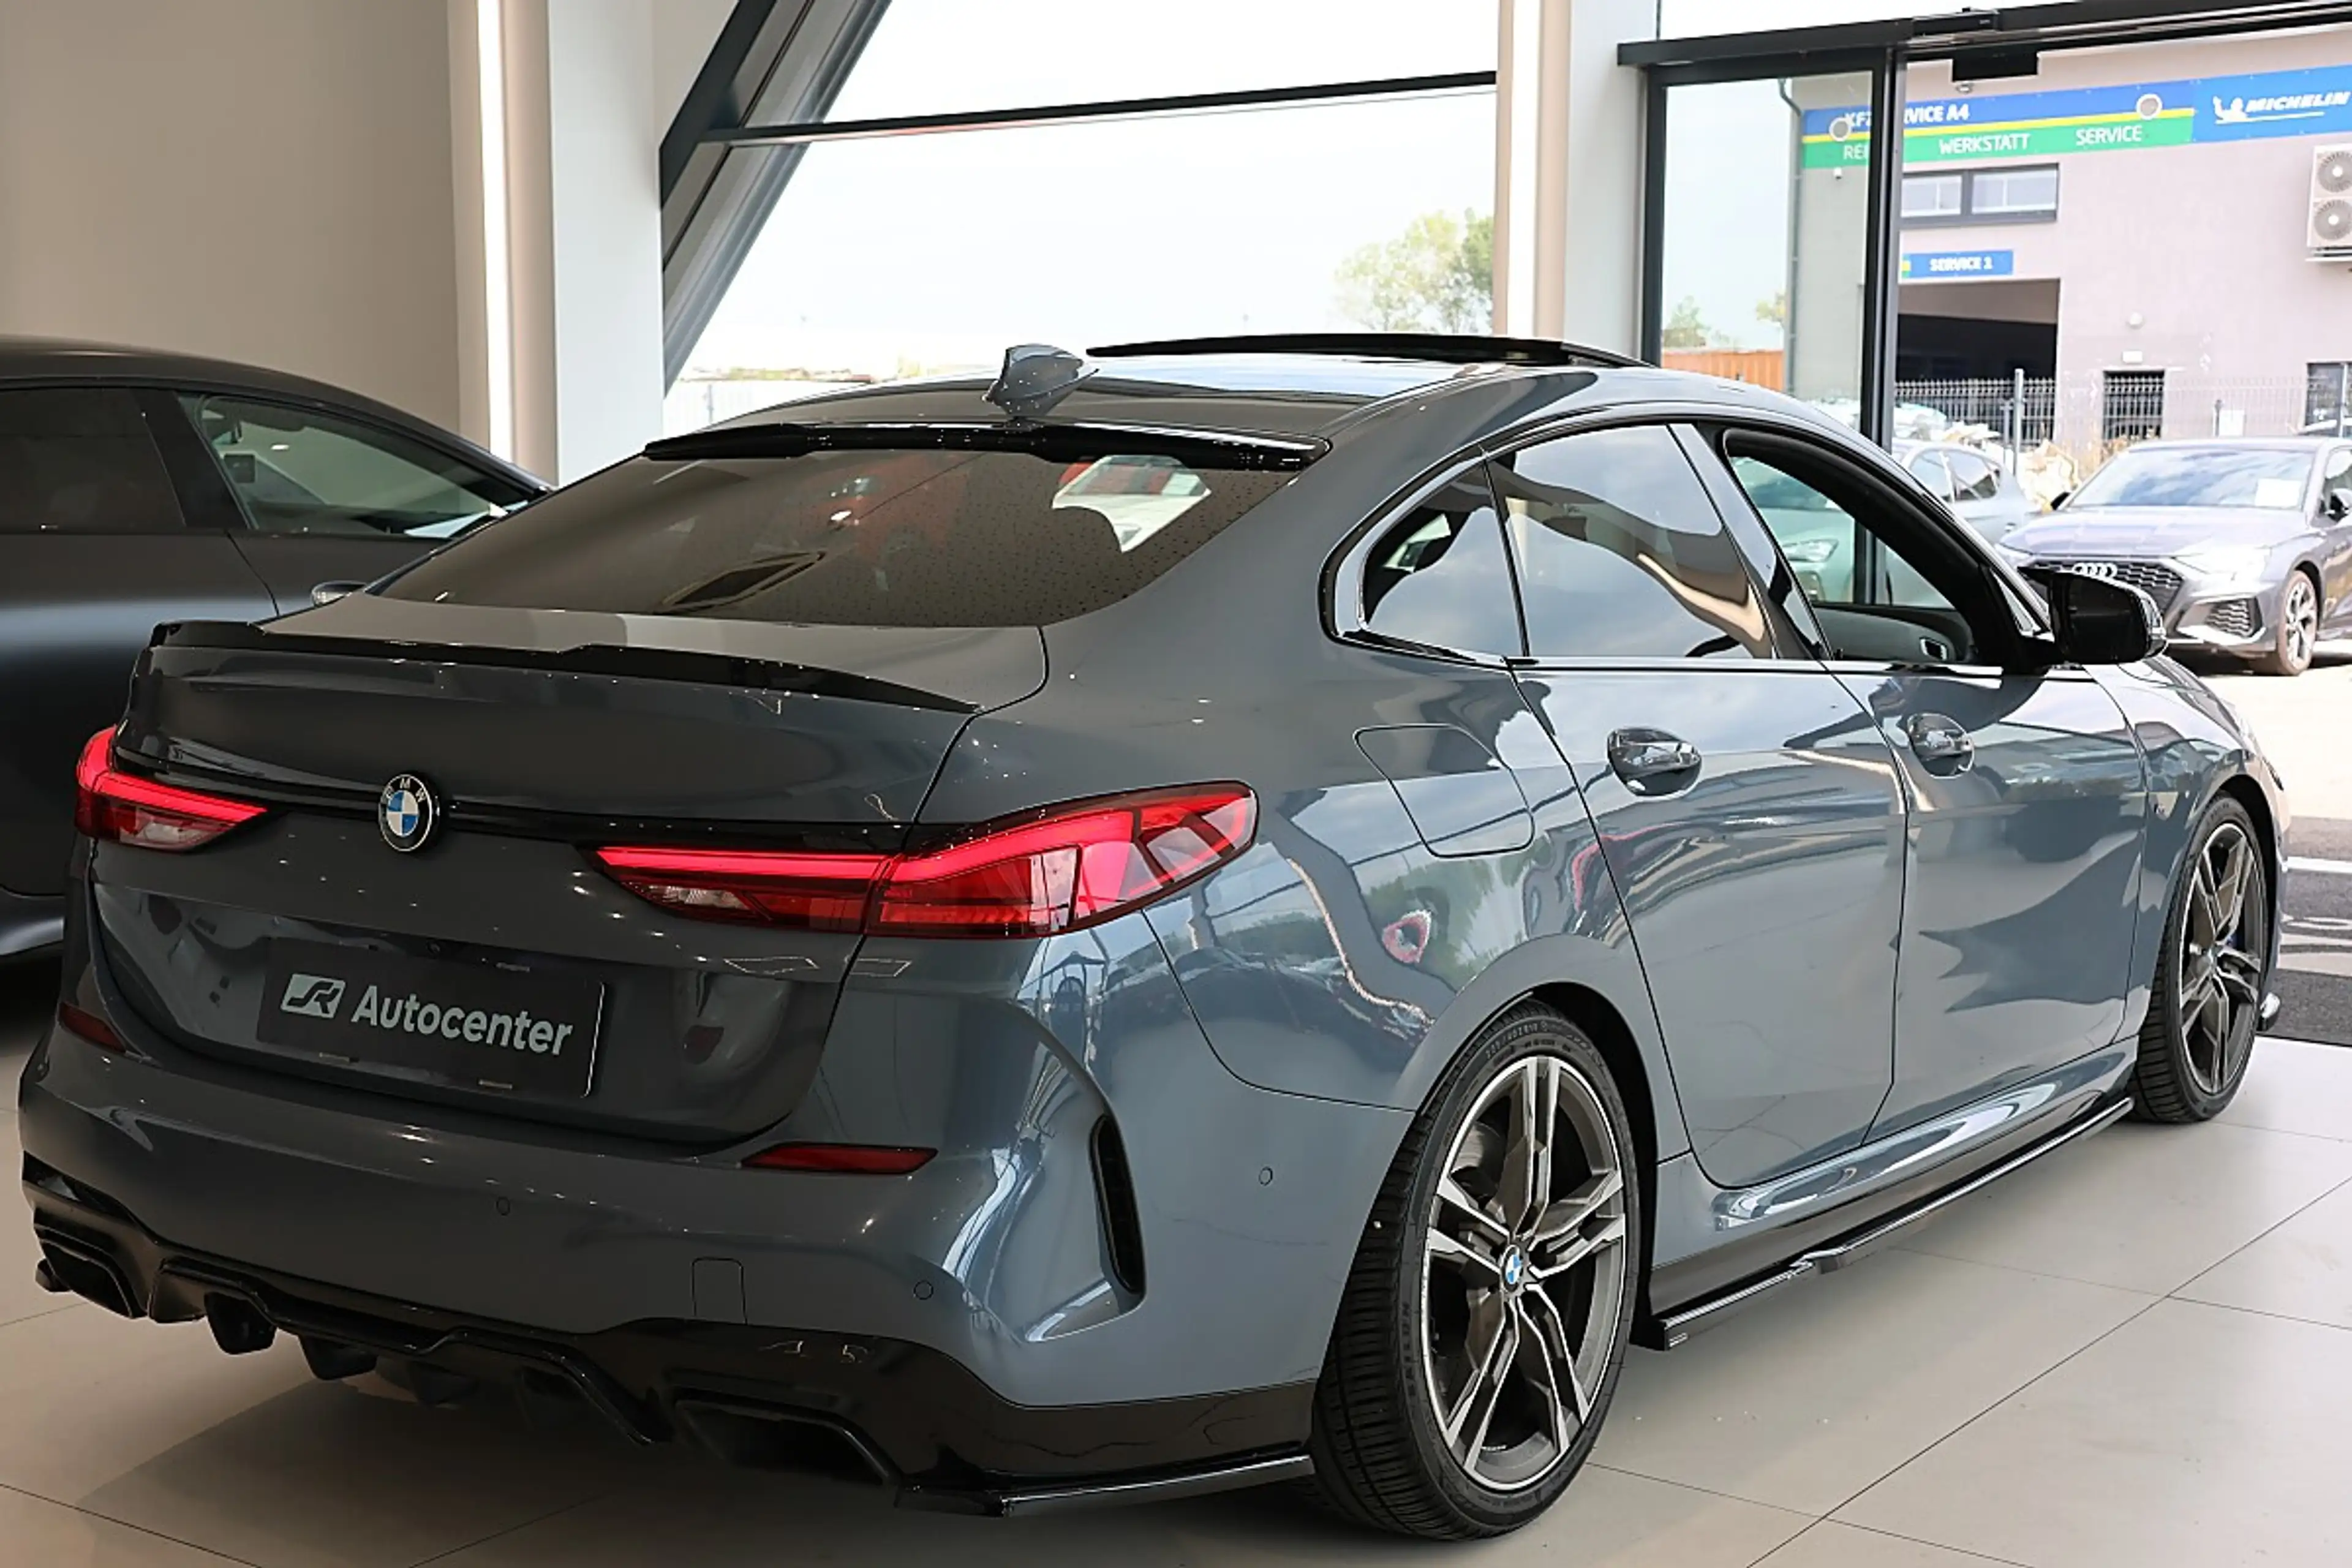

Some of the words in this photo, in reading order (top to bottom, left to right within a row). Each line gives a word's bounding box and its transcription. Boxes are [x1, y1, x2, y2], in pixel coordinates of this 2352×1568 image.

[1947, 104, 1970, 121] A4
[2245, 91, 2351, 113] MICHELIN
[1939, 134, 2029, 154] WERKSTATT
[2076, 125, 2143, 146] SERVICE
[351, 986, 573, 1055] Autocenter
